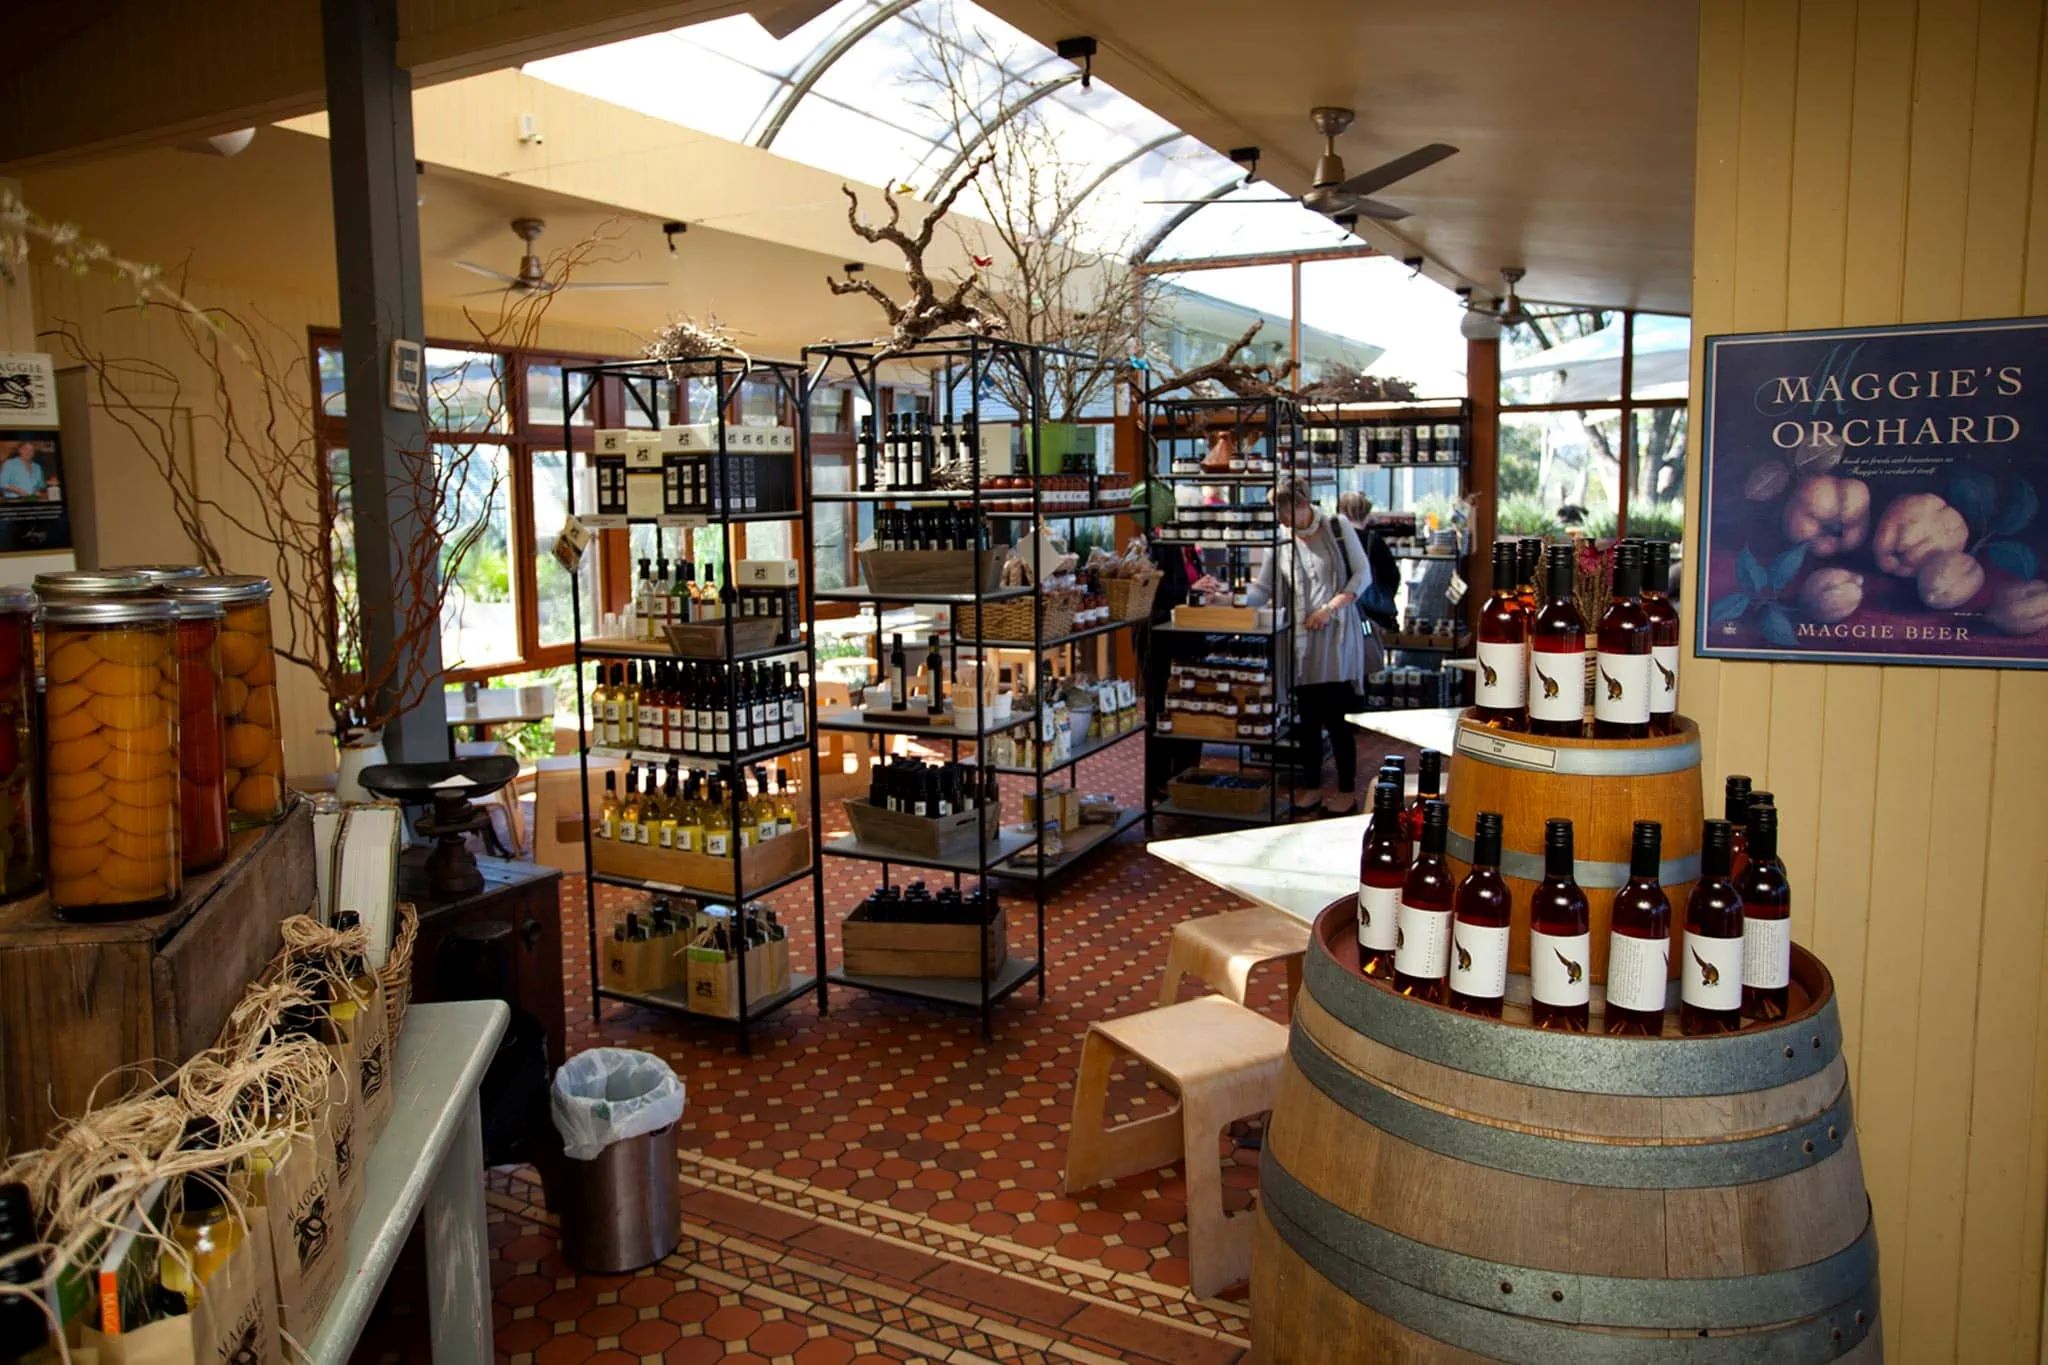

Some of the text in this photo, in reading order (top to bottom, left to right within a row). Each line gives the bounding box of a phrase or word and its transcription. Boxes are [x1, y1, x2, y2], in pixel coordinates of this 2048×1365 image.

[1773, 366, 2023, 404] MAGGIE'S
[1772, 415, 2020, 449] ORCHARD
[1797, 623, 1969, 641] MAGGIE BEER
[216, 1287, 262, 1361] MAGGIE
